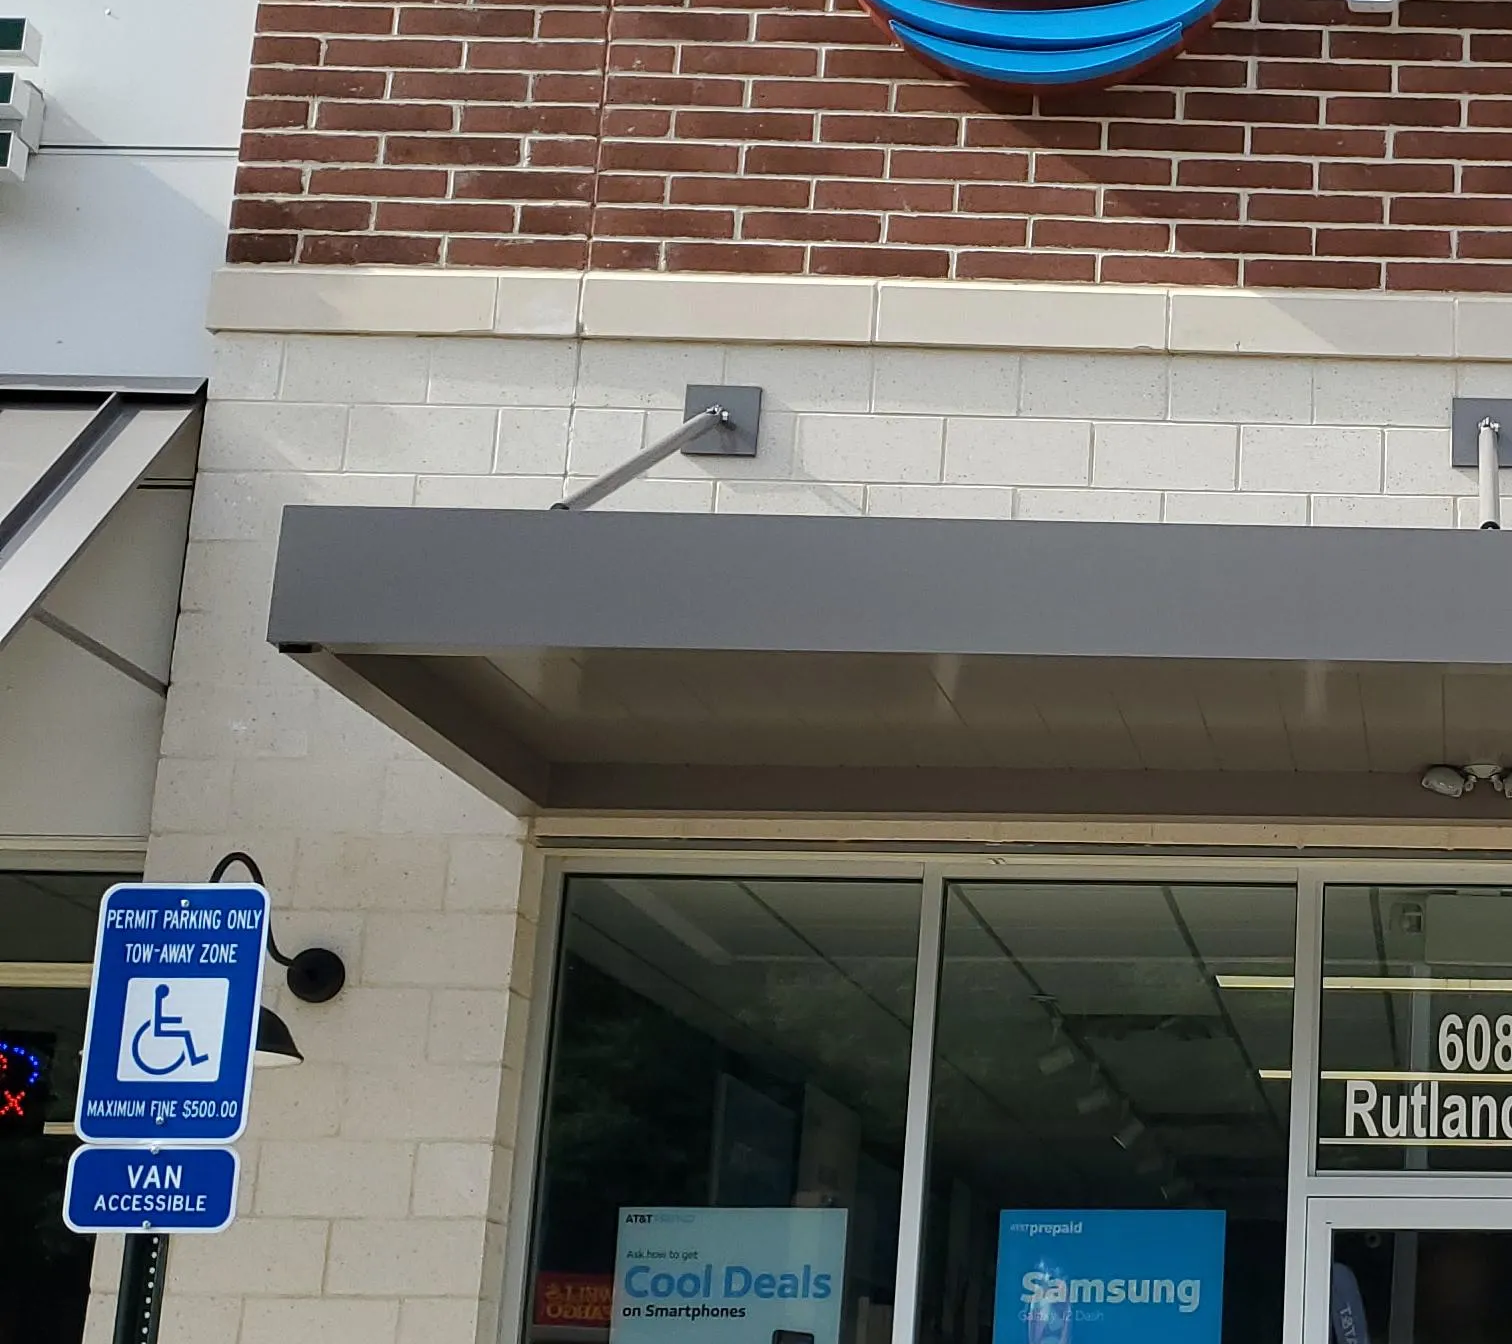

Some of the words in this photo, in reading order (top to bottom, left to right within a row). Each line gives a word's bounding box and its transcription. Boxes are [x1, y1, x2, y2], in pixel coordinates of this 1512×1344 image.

[107, 909, 158, 930] PERMIT
[163, 909, 221, 930] PARKING
[227, 909, 262, 930] ONLY
[126, 943, 195, 963] TOW-AWAY
[200, 943, 238, 963] ZONE
[87, 1100, 146, 1118] MAXIMUM
[150, 1100, 178, 1118] FINE
[182, 1099, 238, 1119] $500.00
[127, 1165, 182, 1189] VAN
[94, 1194, 207, 1212] ACCESSIBLE
[625, 1214, 653, 1224] AT&T
[1029, 1221, 1083, 1236] prepaid
[626, 1250, 643, 1259] Ask
[647, 1249, 667, 1259] how
[669, 1250, 680, 1260] to
[681, 1250, 699, 1261] get
[624, 1264, 713, 1299] Cool
[723, 1264, 832, 1299] Deals
[1020, 1271, 1201, 1313] Samsung
[622, 1307, 641, 1318] on
[645, 1304, 746, 1321] Smartphones
